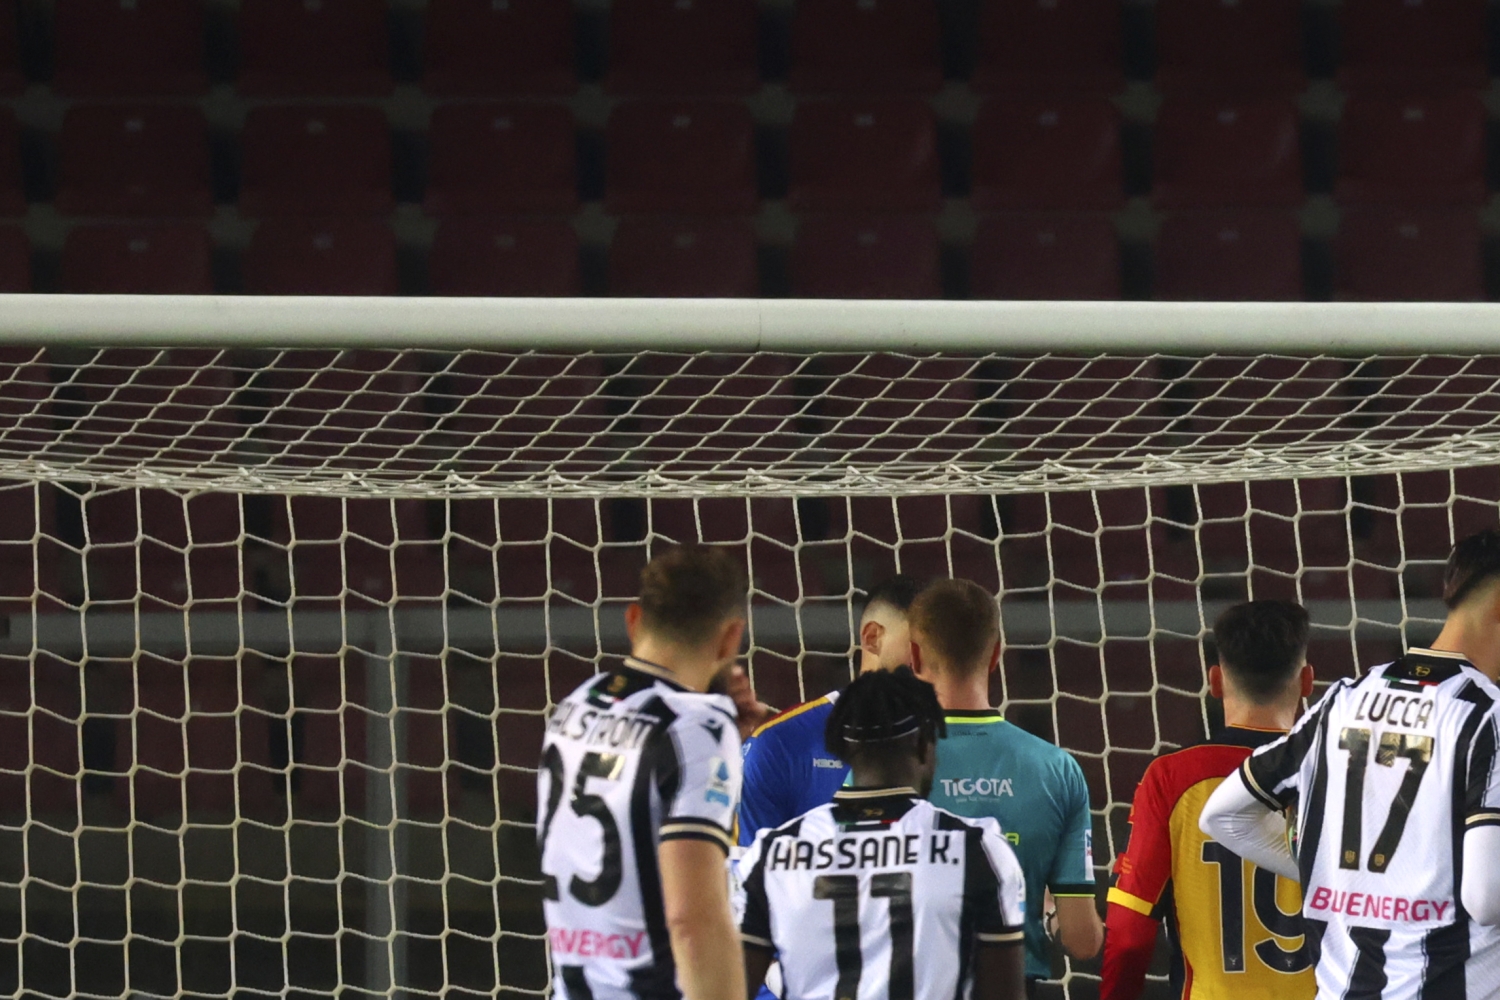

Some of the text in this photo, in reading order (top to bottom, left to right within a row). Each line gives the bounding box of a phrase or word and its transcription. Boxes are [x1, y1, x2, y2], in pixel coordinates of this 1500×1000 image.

[1354, 691, 1434, 729] LUCCA
[1338, 727, 1435, 874] 17
[771, 834, 960, 871] HASSANE K.
[1201, 839, 1315, 975] 19
